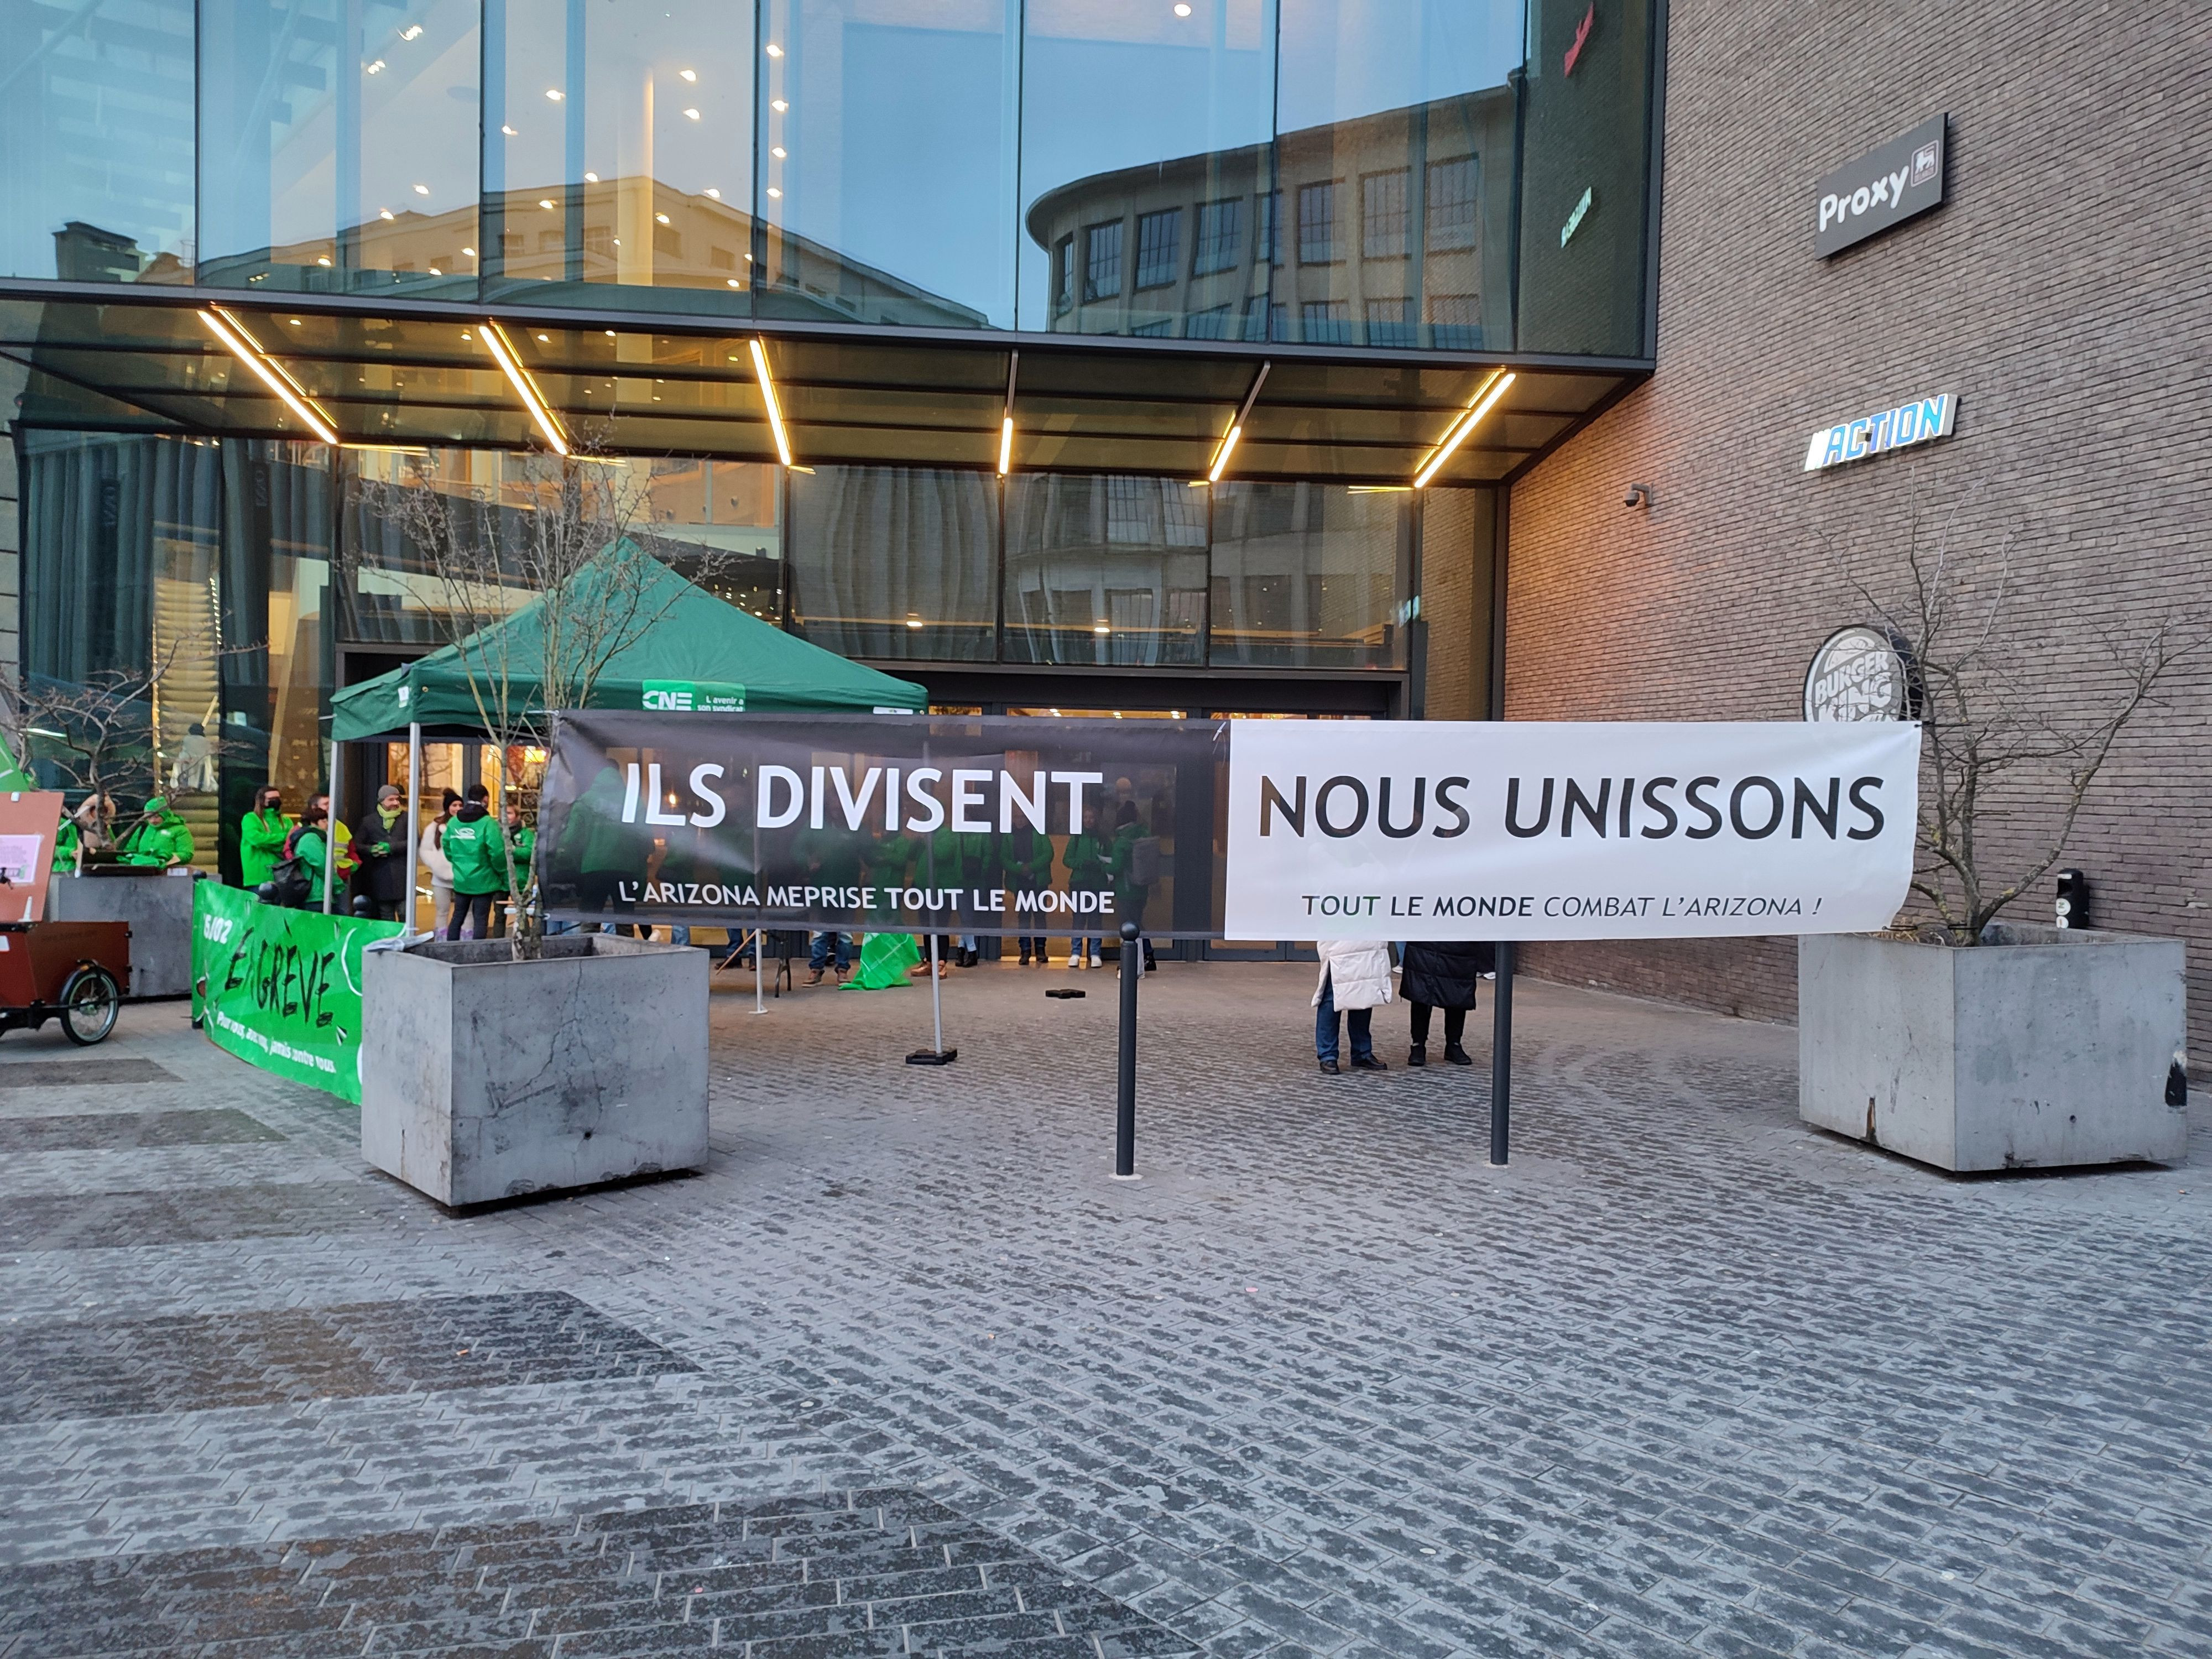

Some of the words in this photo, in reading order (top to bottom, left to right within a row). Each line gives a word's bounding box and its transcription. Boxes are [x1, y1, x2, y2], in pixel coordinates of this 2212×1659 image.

[1819, 165, 1910, 232] Proxy
[1822, 393, 1948, 467] ACTION
[642, 690, 693, 711] CNE
[1815, 651, 1889, 707] BURGER
[621, 763, 726, 828] ILS
[757, 765, 1104, 835] DIVISENT
[1259, 775, 1470, 838] NOUS
[1505, 776, 1885, 841] UNISSONS
[619, 881, 760, 906] L'ARIZONA
[766, 886, 877, 909] MEPRISE
[884, 888, 964, 911] TOUT
[973, 889, 1006, 912] LE
[1014, 890, 1115, 914] MONDE
[1302, 895, 1381, 916] TOUT
[1391, 896, 1424, 916] LE
[1432, 896, 1535, 917] MONDE
[1544, 896, 1656, 917] COMBAT
[1662, 897, 1802, 916] L'ARIZONA
[1812, 898, 1823, 916] !
